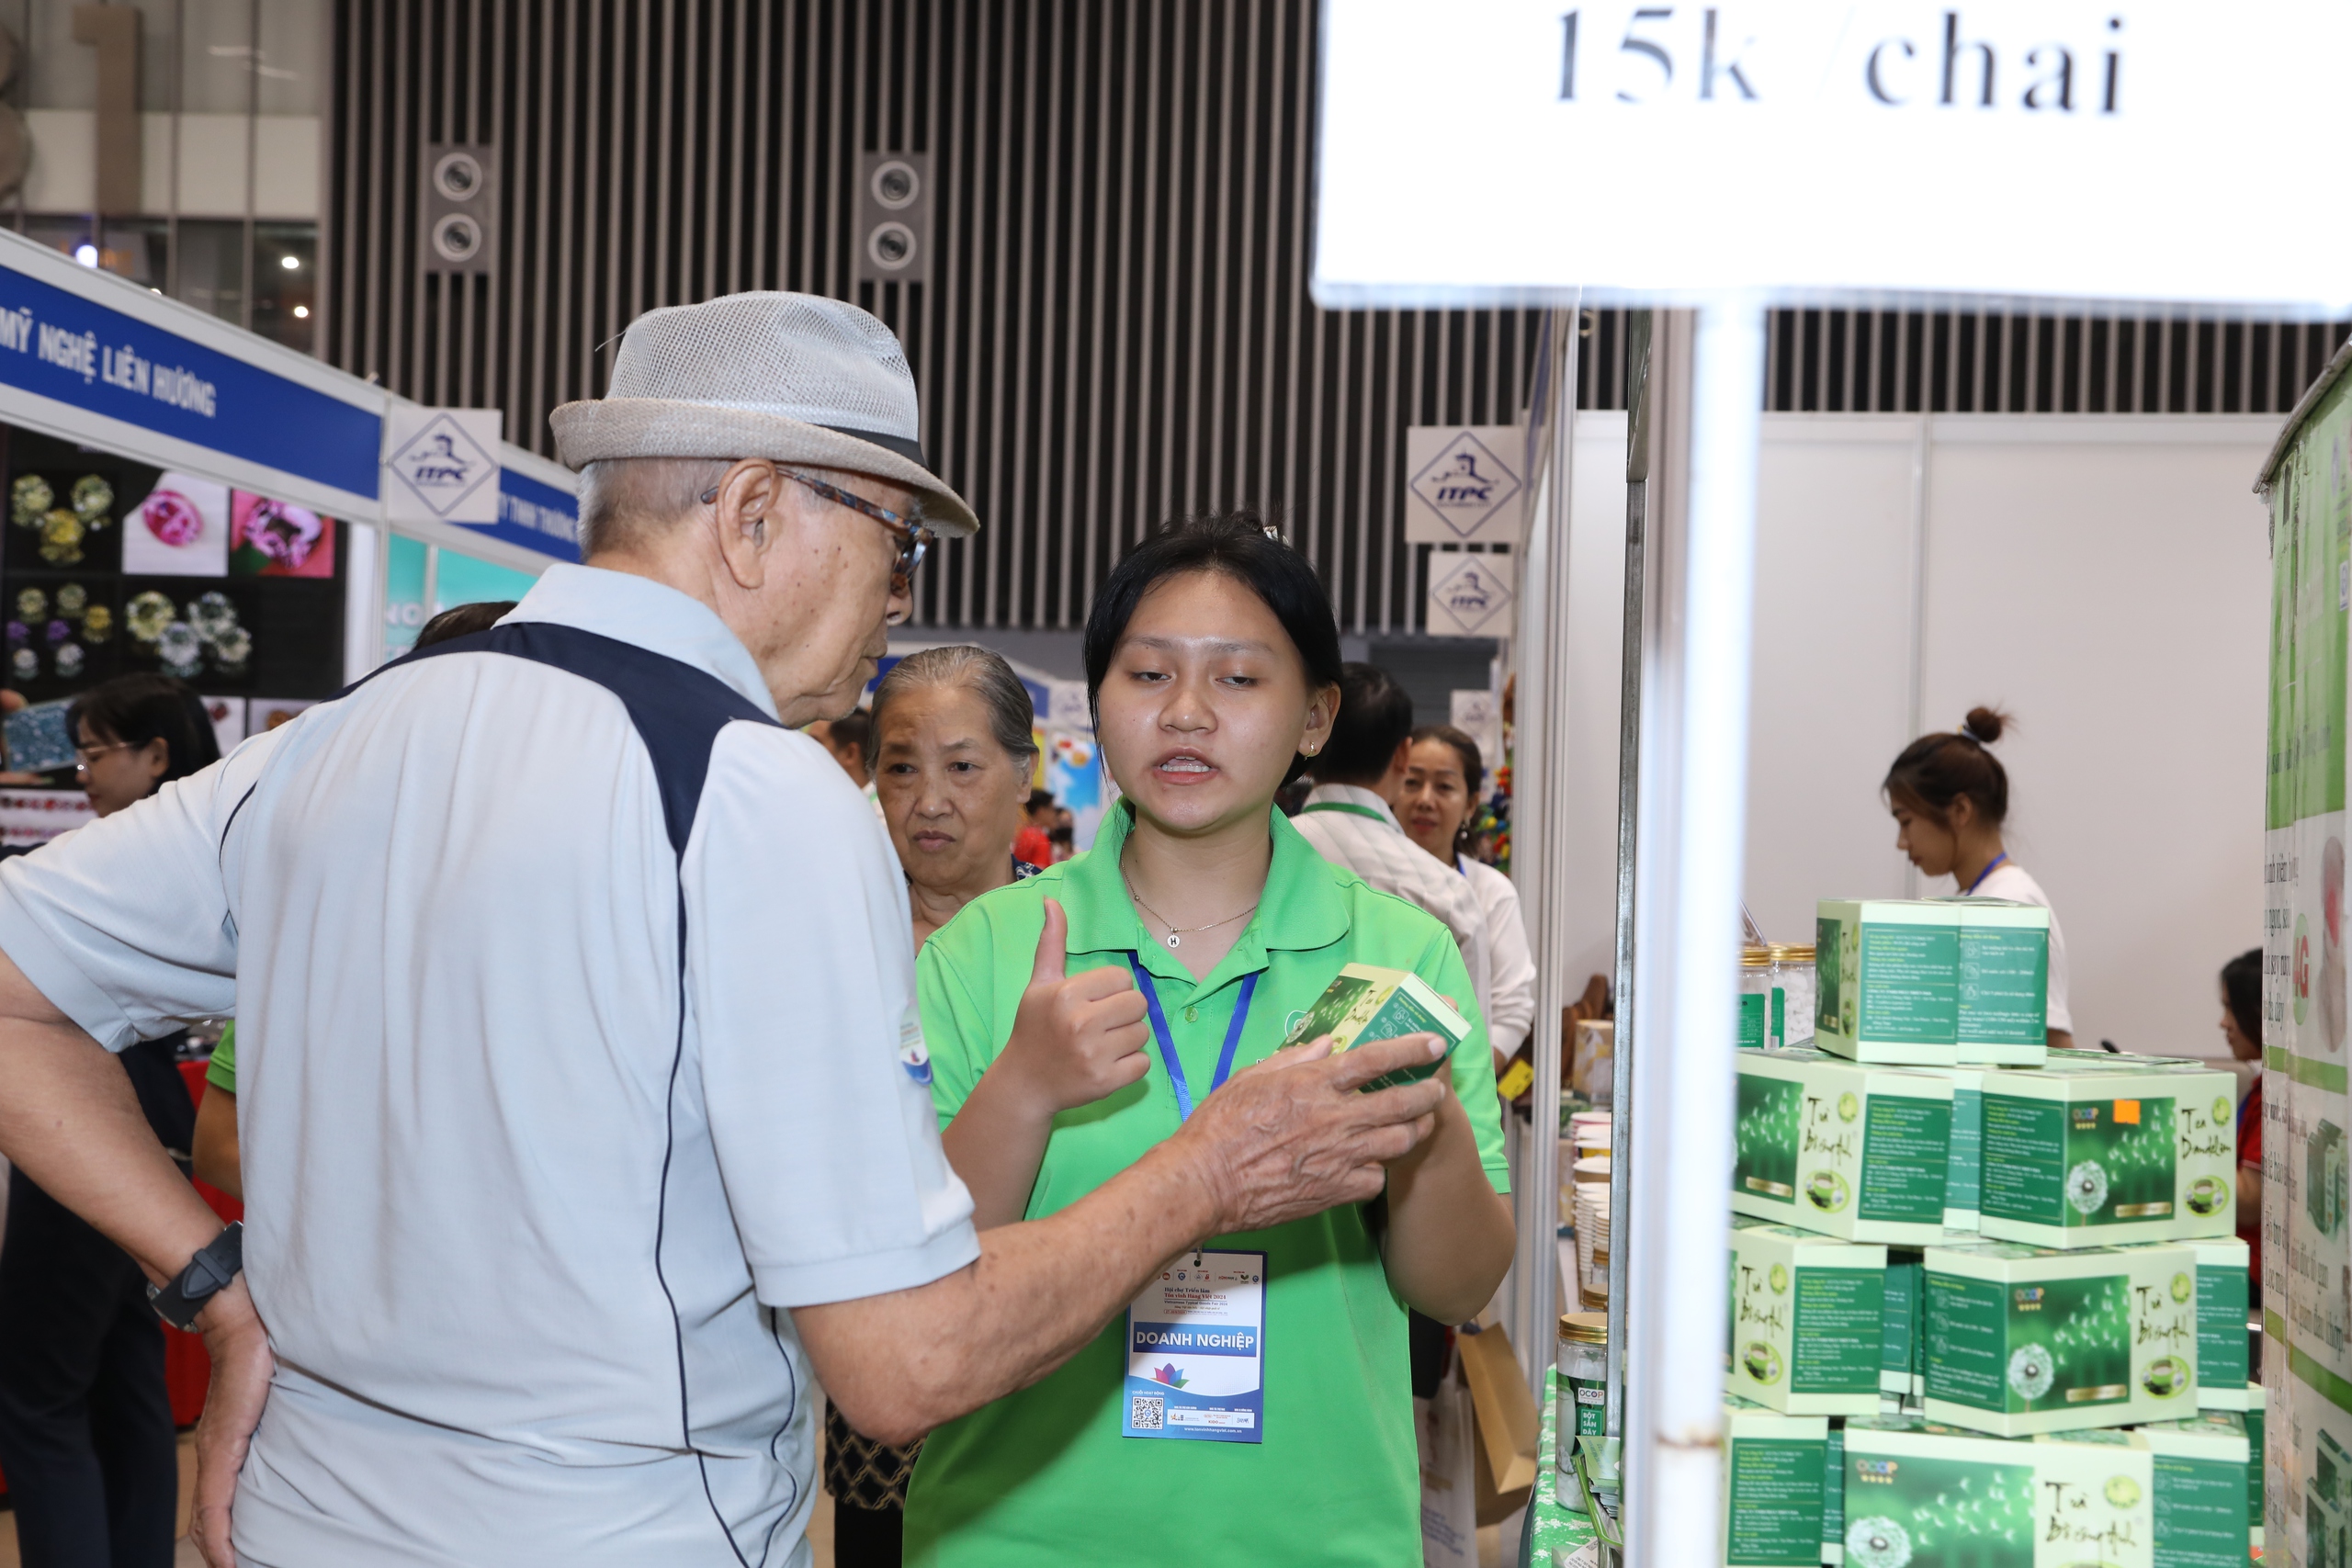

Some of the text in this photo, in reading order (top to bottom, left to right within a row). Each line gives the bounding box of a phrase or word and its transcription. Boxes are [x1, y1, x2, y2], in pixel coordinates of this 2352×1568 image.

[38, 321, 97, 385] NGHỆ
[102, 344, 151, 396] LIÊN
[1436, 486, 1493, 501] ITPC
[2292, 934, 2310, 999] 4G
[2180, 1107, 2207, 1134] Tea
[1136, 1331, 1255, 1351] DOANH NGHIỆP
[1579, 1389, 1604, 1398] OCOP
[1583, 1411, 1596, 1420] BỘT
[1582, 1427, 1597, 1436] DÂY
